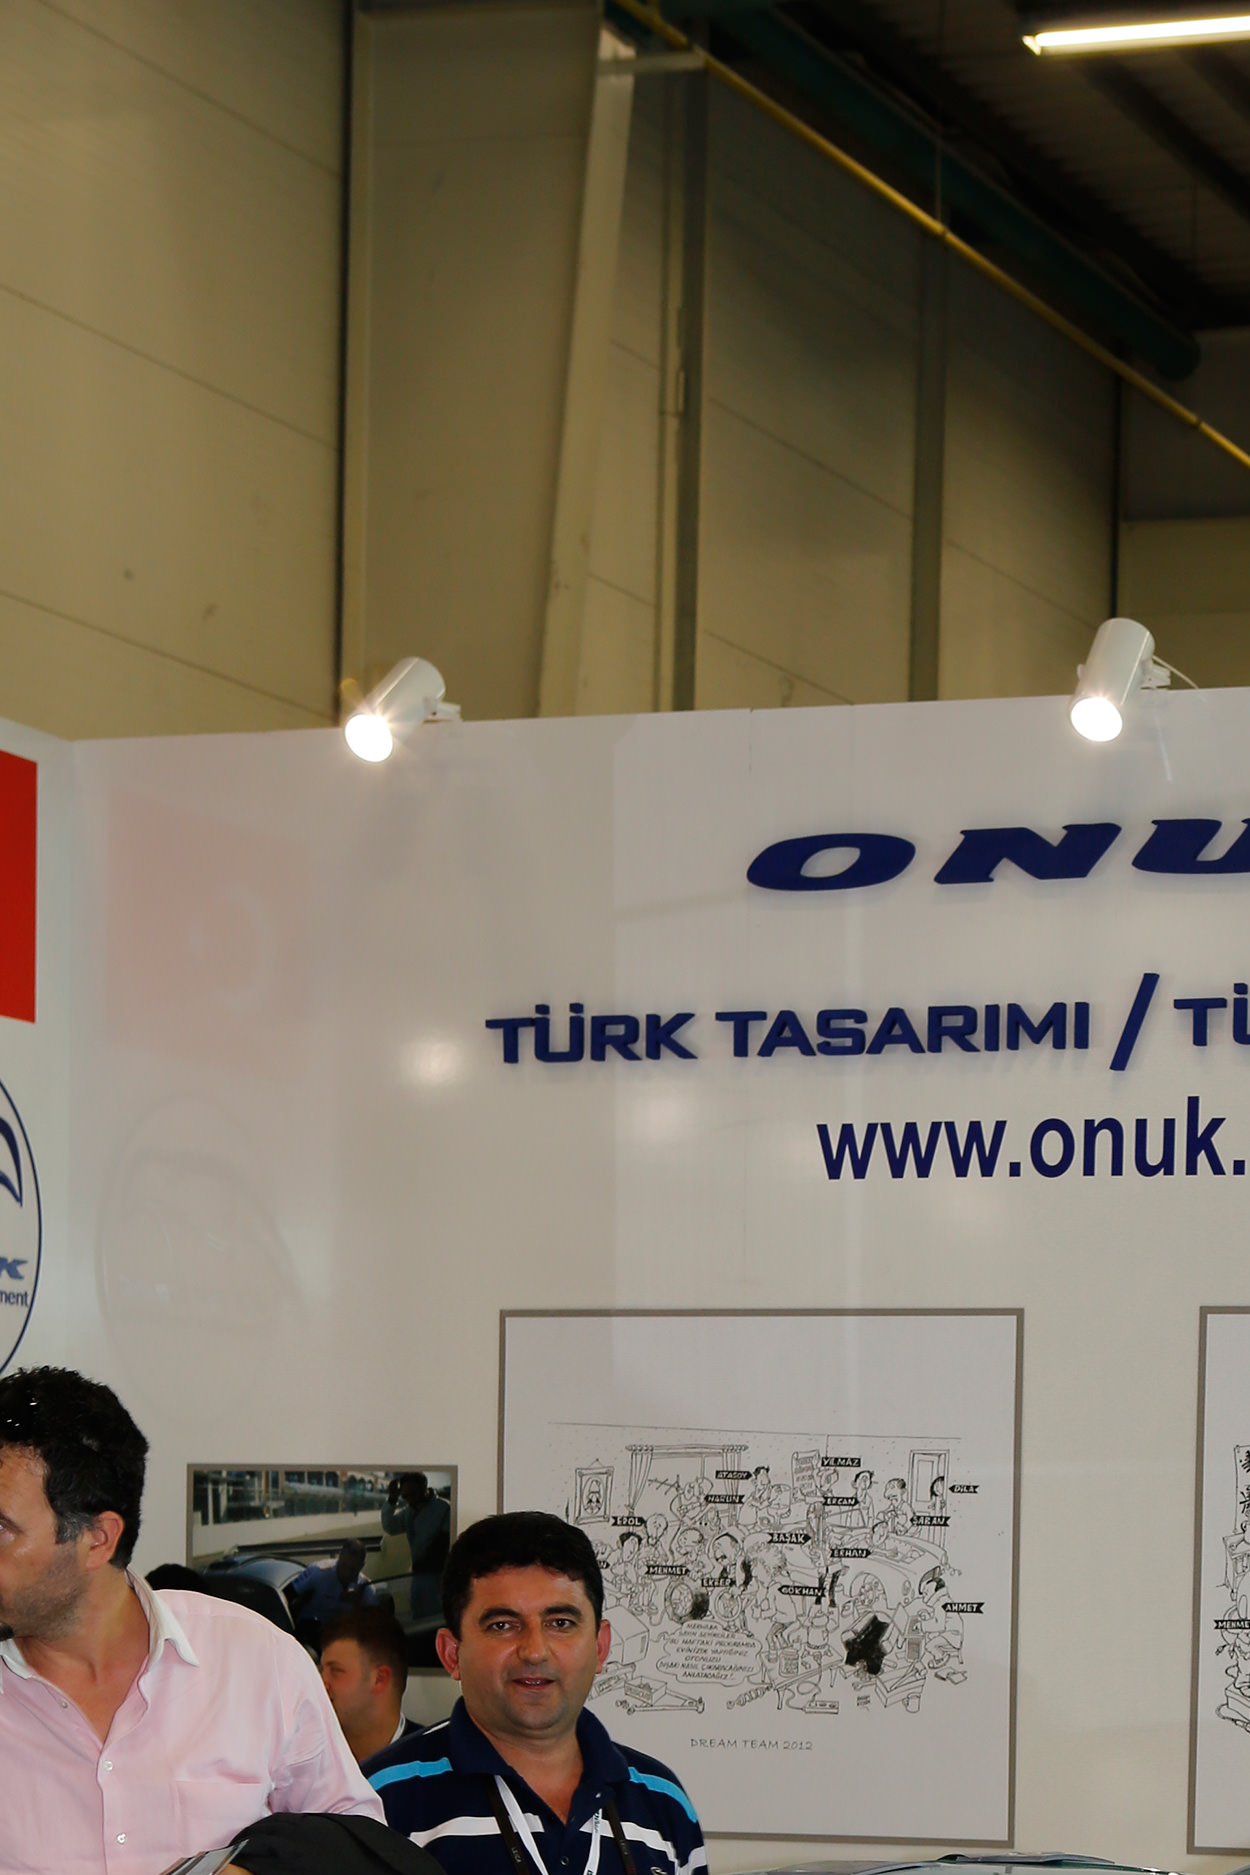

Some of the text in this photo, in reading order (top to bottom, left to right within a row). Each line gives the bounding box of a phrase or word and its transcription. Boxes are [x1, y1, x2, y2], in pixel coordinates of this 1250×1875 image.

[486, 1003, 694, 1063] TÜRK
[716, 1002, 1090, 1057] TASARIMI
[690, 1738, 813, 1751] DREAM TEAM 2012
